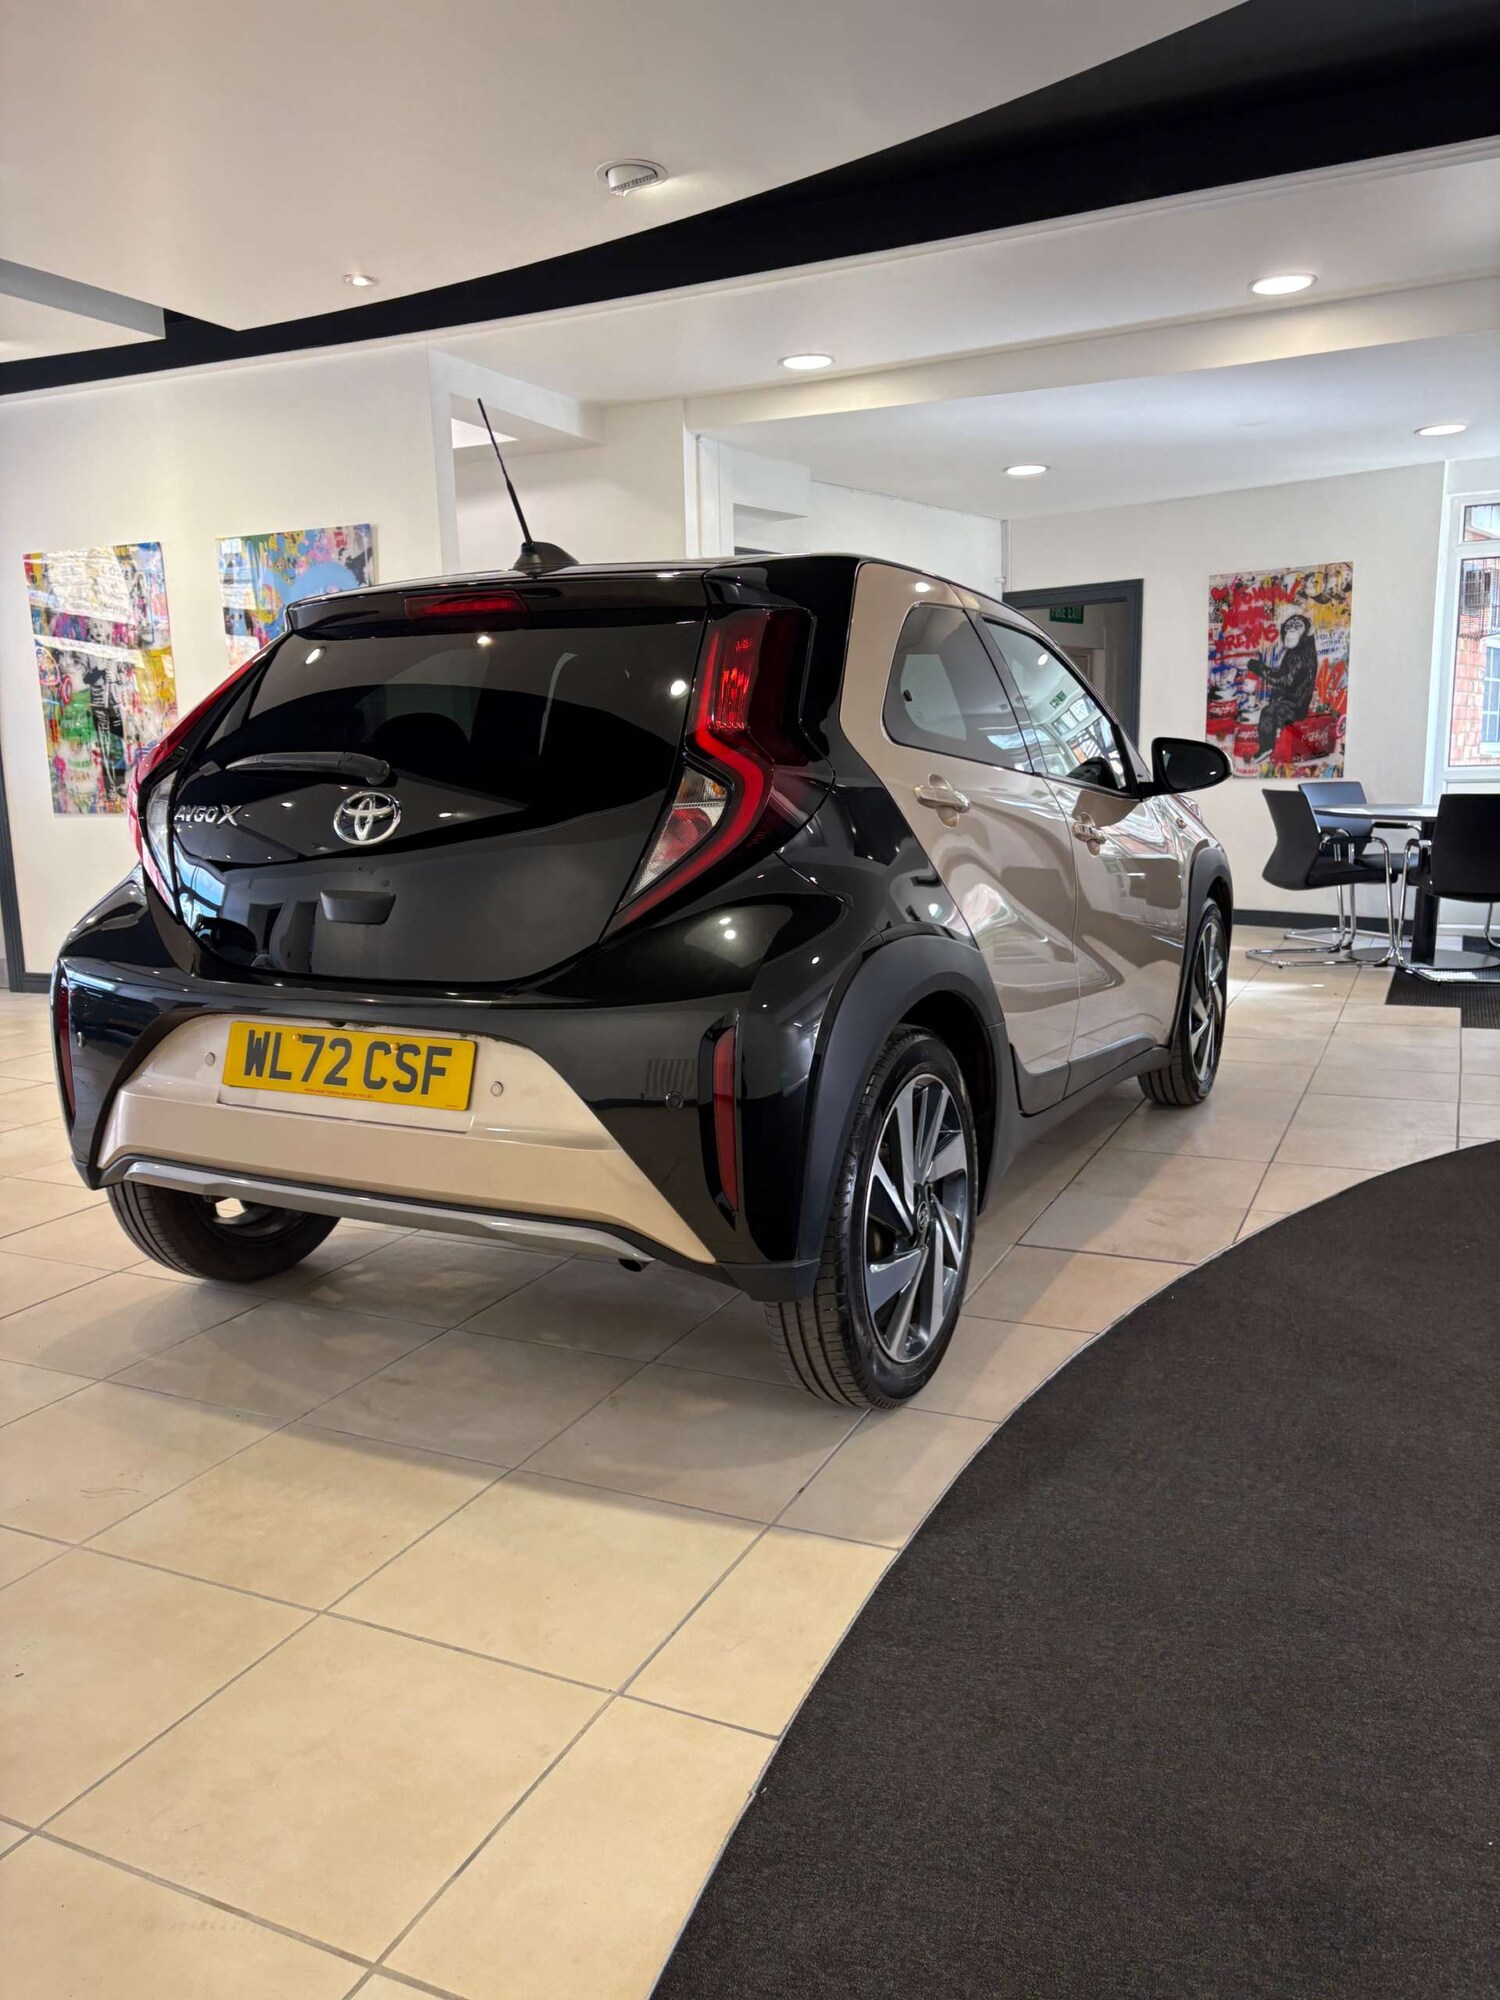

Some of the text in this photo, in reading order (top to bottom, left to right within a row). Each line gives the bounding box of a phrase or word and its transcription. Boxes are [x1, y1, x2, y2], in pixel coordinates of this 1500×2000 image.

[174, 804, 242, 826] AYGO X
[244, 1029, 453, 1096] WL72 CSF
